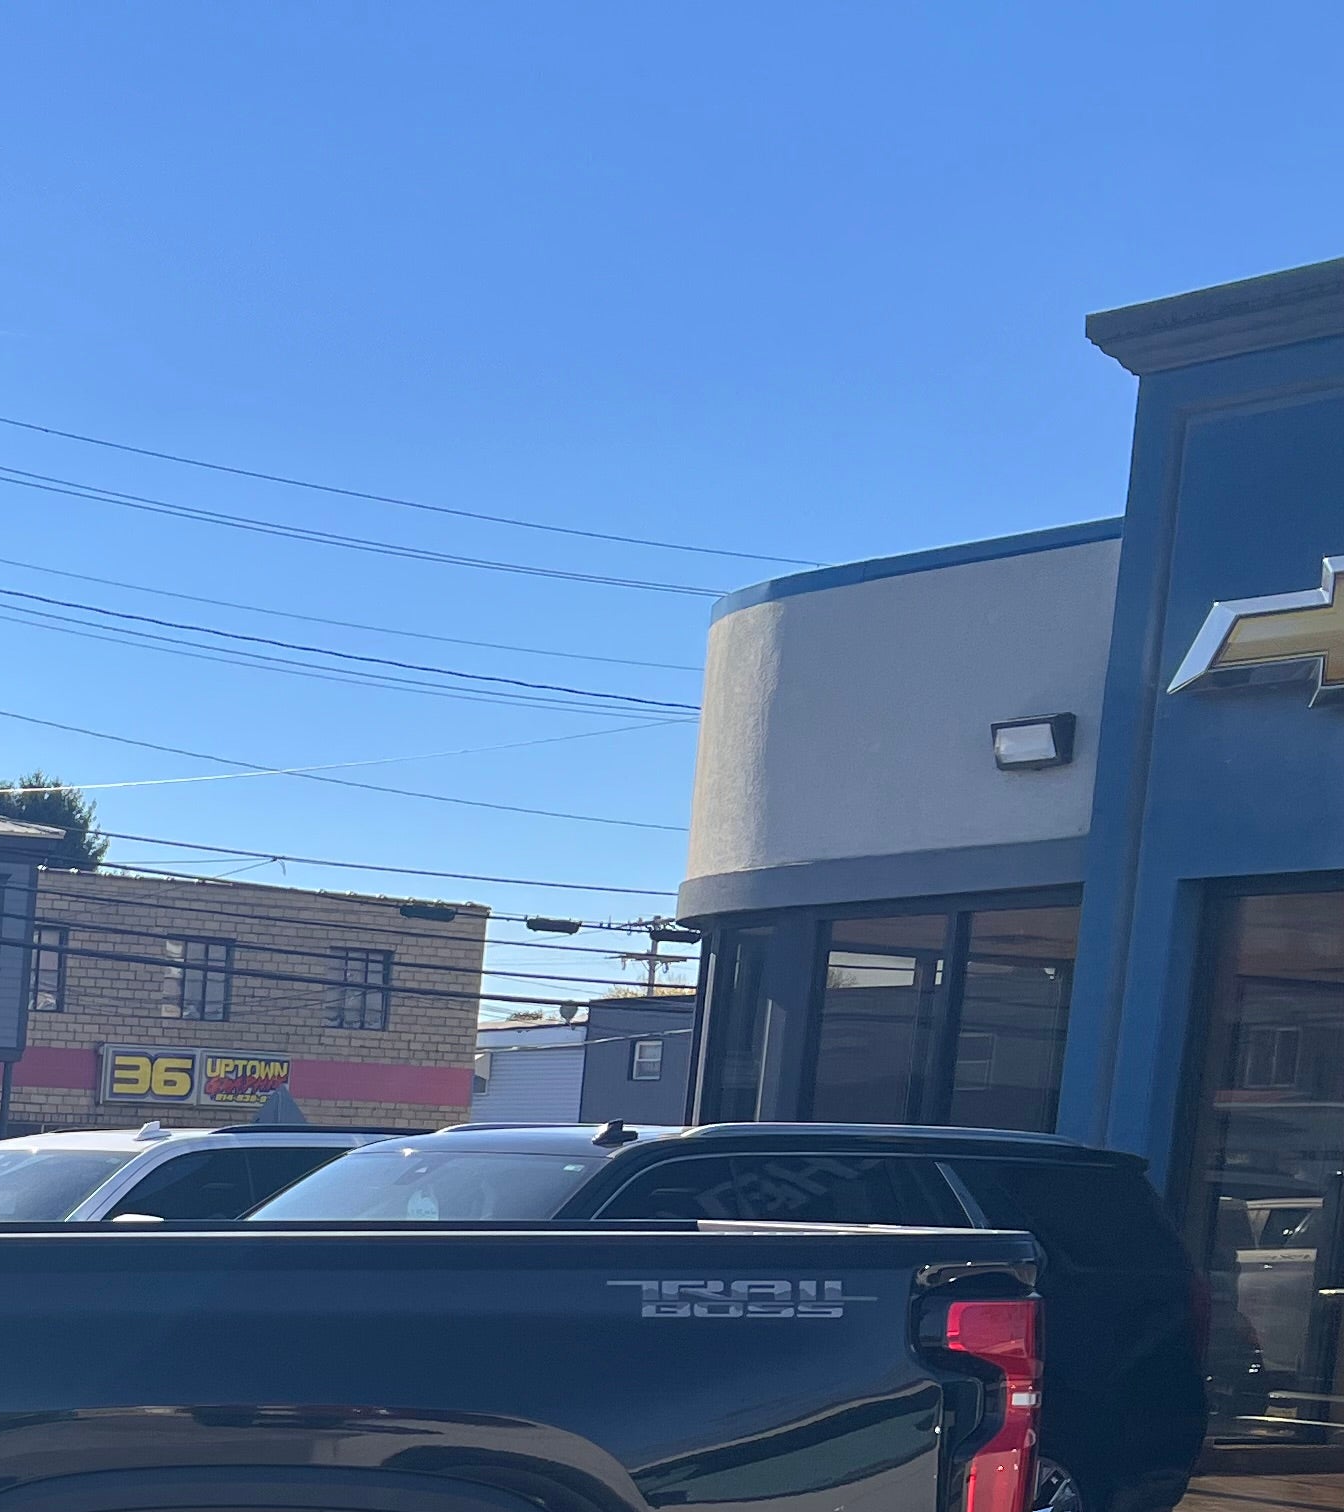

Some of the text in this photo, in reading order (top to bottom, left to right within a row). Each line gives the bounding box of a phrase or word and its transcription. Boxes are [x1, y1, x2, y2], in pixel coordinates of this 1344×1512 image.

[112, 1055, 193, 1097] 36
[206, 1057, 289, 1081] UPTOWN
[607, 1280, 878, 1301] TRAIL
[641, 1301, 844, 1319] BOSS
